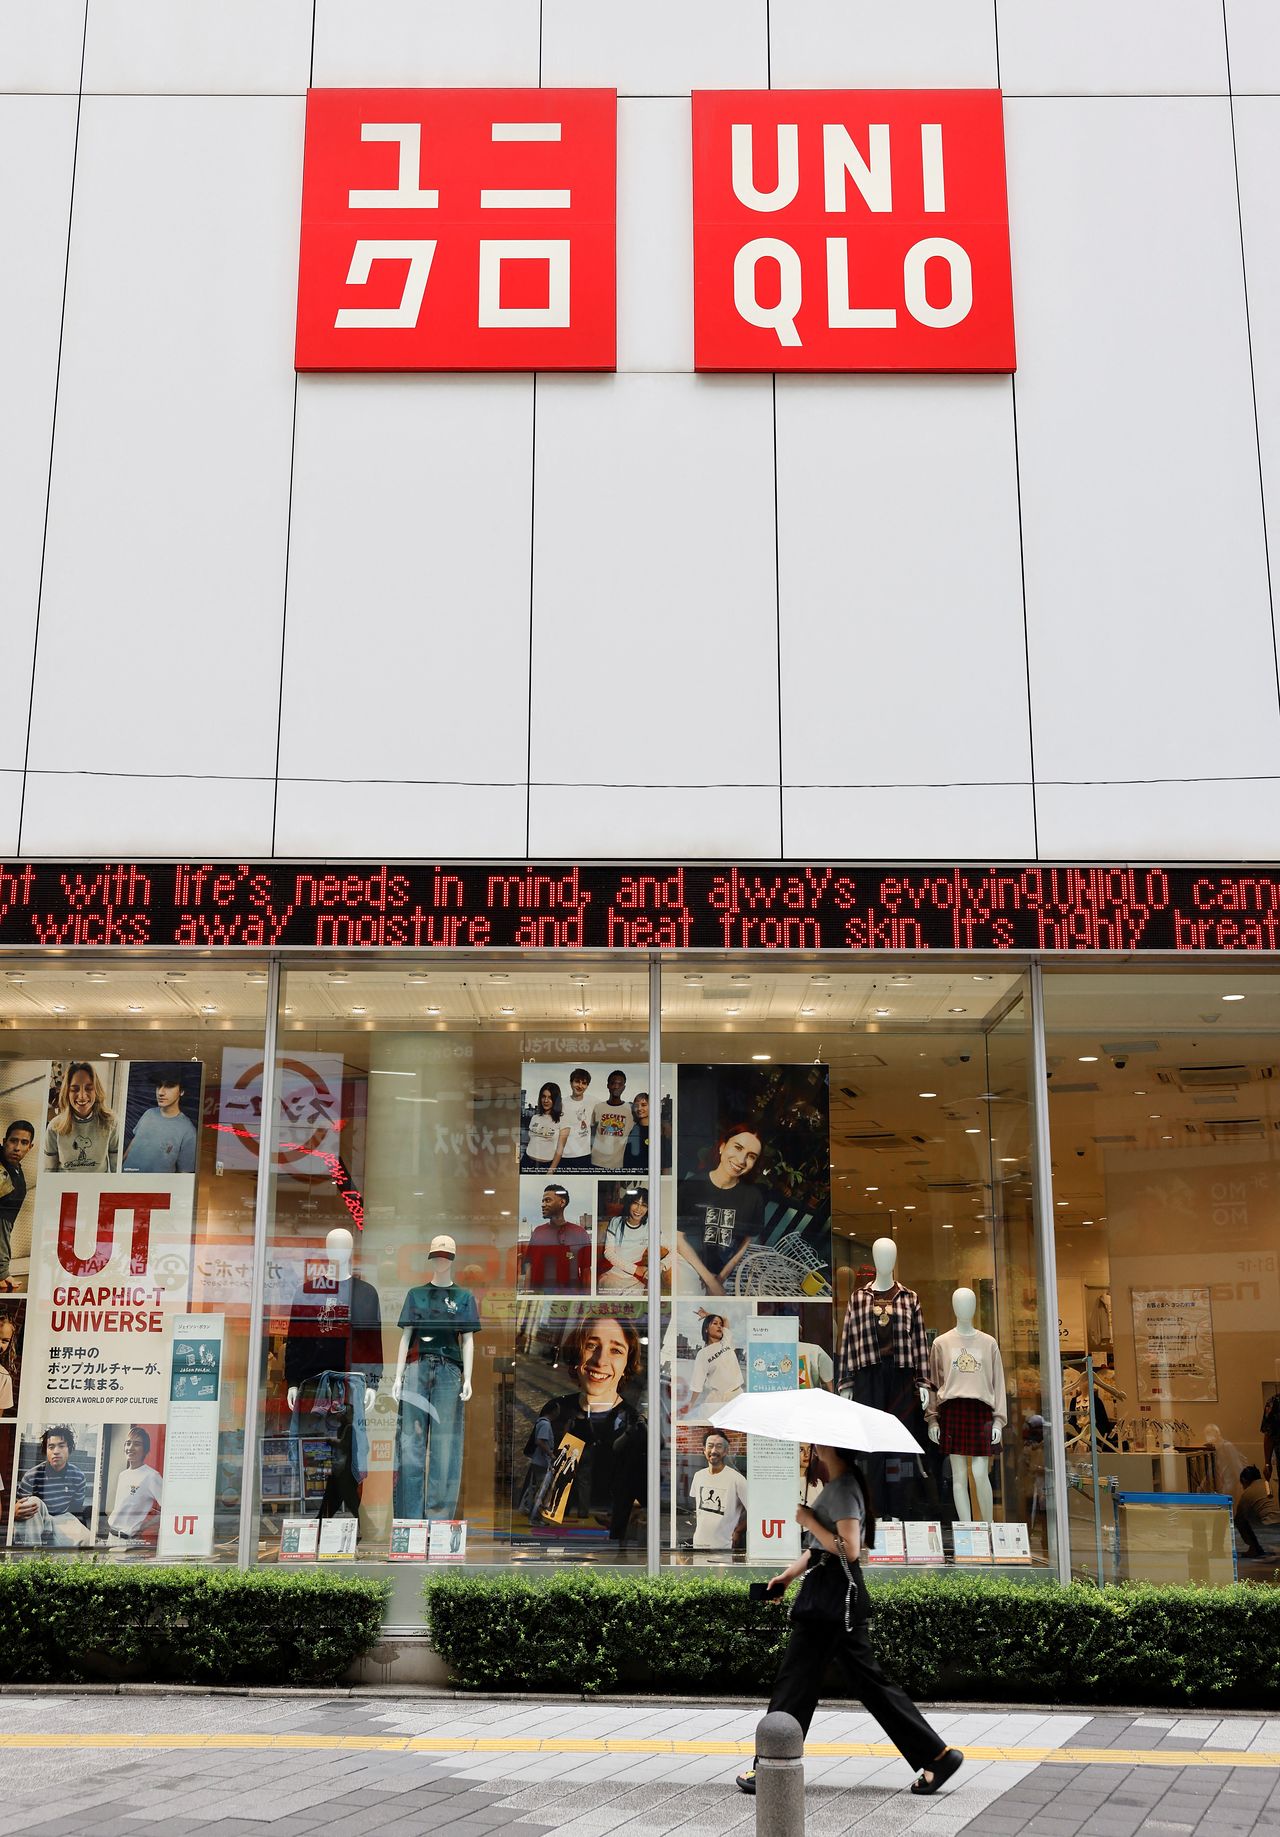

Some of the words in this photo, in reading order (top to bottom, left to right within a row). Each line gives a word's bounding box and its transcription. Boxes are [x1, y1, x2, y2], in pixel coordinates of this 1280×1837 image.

[348, 122, 571, 209] ユニ
[731, 122, 947, 214] UNI
[333, 239, 571, 329] クロ
[732, 236, 975, 348] QLO
[61, 865, 150, 905] with
[175, 866, 271, 905] life's
[296, 865, 409, 906] needs
[434, 867, 463, 906] in
[488, 866, 591, 907] mind,
[617, 868, 683, 908] and
[709, 867, 855, 908] always
[1194, 878, 1280, 910] cam
[32, 905, 150, 946] wicks
[175, 905, 292, 946] away
[316, 906, 490, 947] moisture
[516, 906, 585, 948] and
[608, 907, 693, 948] heat
[720, 907, 820, 949] from
[845, 907, 928, 950] skin.
[953, 908, 1013, 950] It's
[1038, 908, 1151, 950] highly
[1175, 908, 1279, 951] breat
[57, 1192, 171, 1278] UT
[53, 1286, 165, 1307] GRAPHIC-T
[51, 1311, 164, 1333] UNIVERSE
[49, 1346, 100, 1360] 世界中の
[47, 1362, 163, 1375] ポップカルチャーが、
[46, 1378, 125, 1391] ここに集まる。
[45, 1396, 75, 1404] DISCOVER
[81, 1396, 105, 1404] WORLD
[105, 1396, 114, 1404] OF
[115, 1396, 128, 1404] POP
[129, 1396, 159, 1404] CULTURE
[174, 1515, 199, 1535] UT
[762, 1519, 786, 1539] UT
